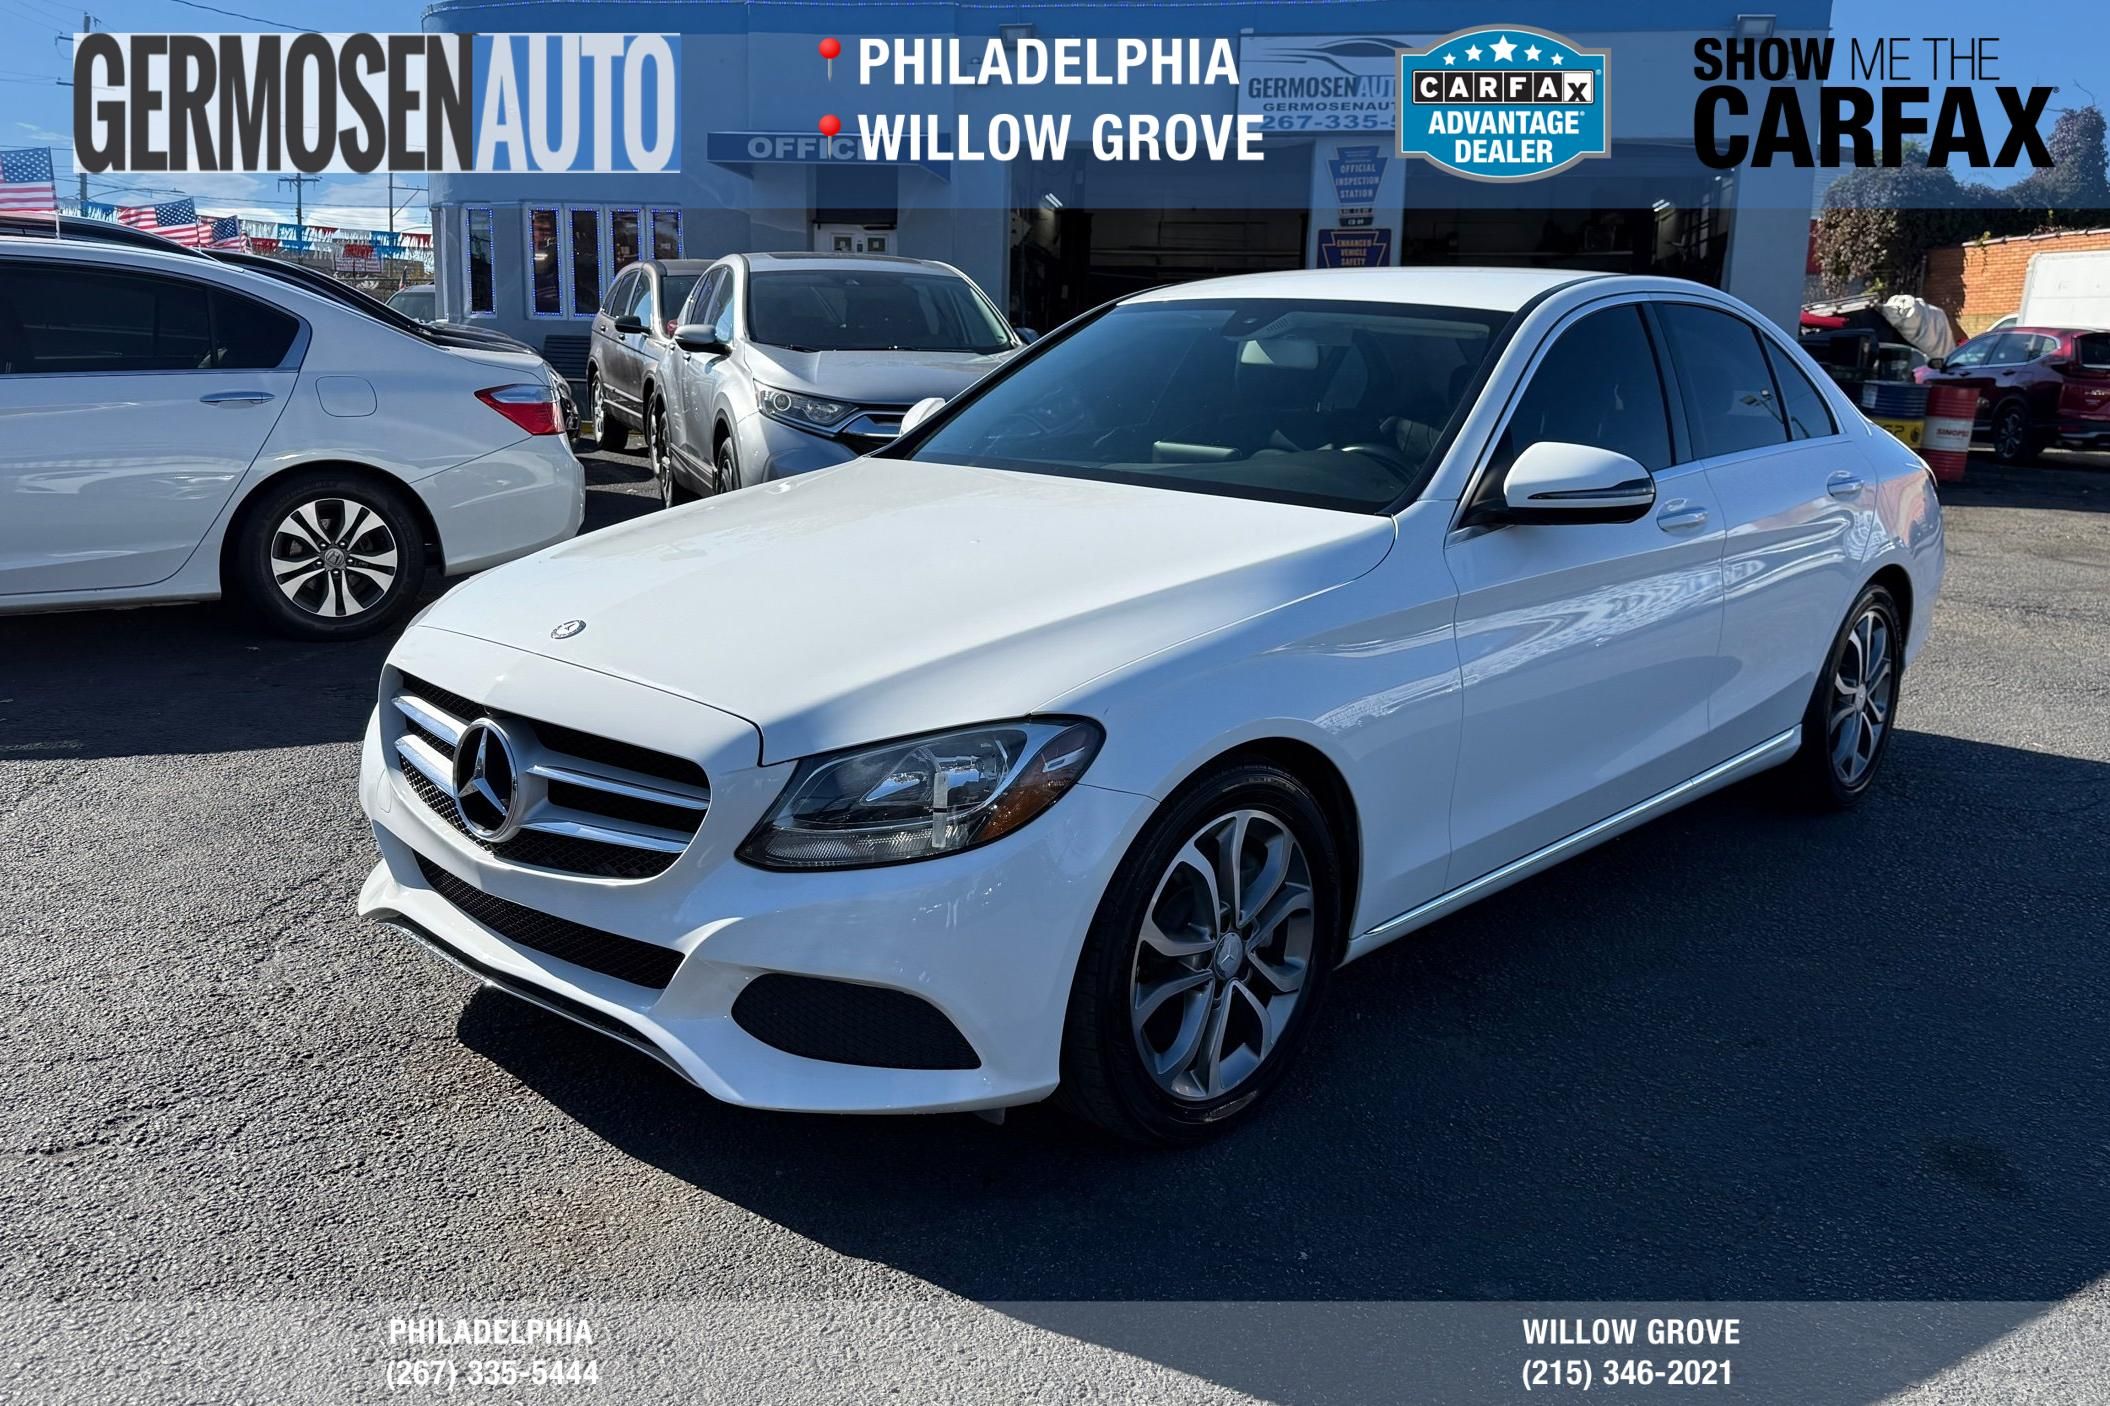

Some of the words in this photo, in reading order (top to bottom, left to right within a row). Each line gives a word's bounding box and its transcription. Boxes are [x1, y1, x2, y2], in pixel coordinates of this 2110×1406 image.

[1340, 163, 1376, 174] OFFICIAL
[1335, 176, 1380, 186] INSPECTION
[1340, 189, 1373, 199] STATION
